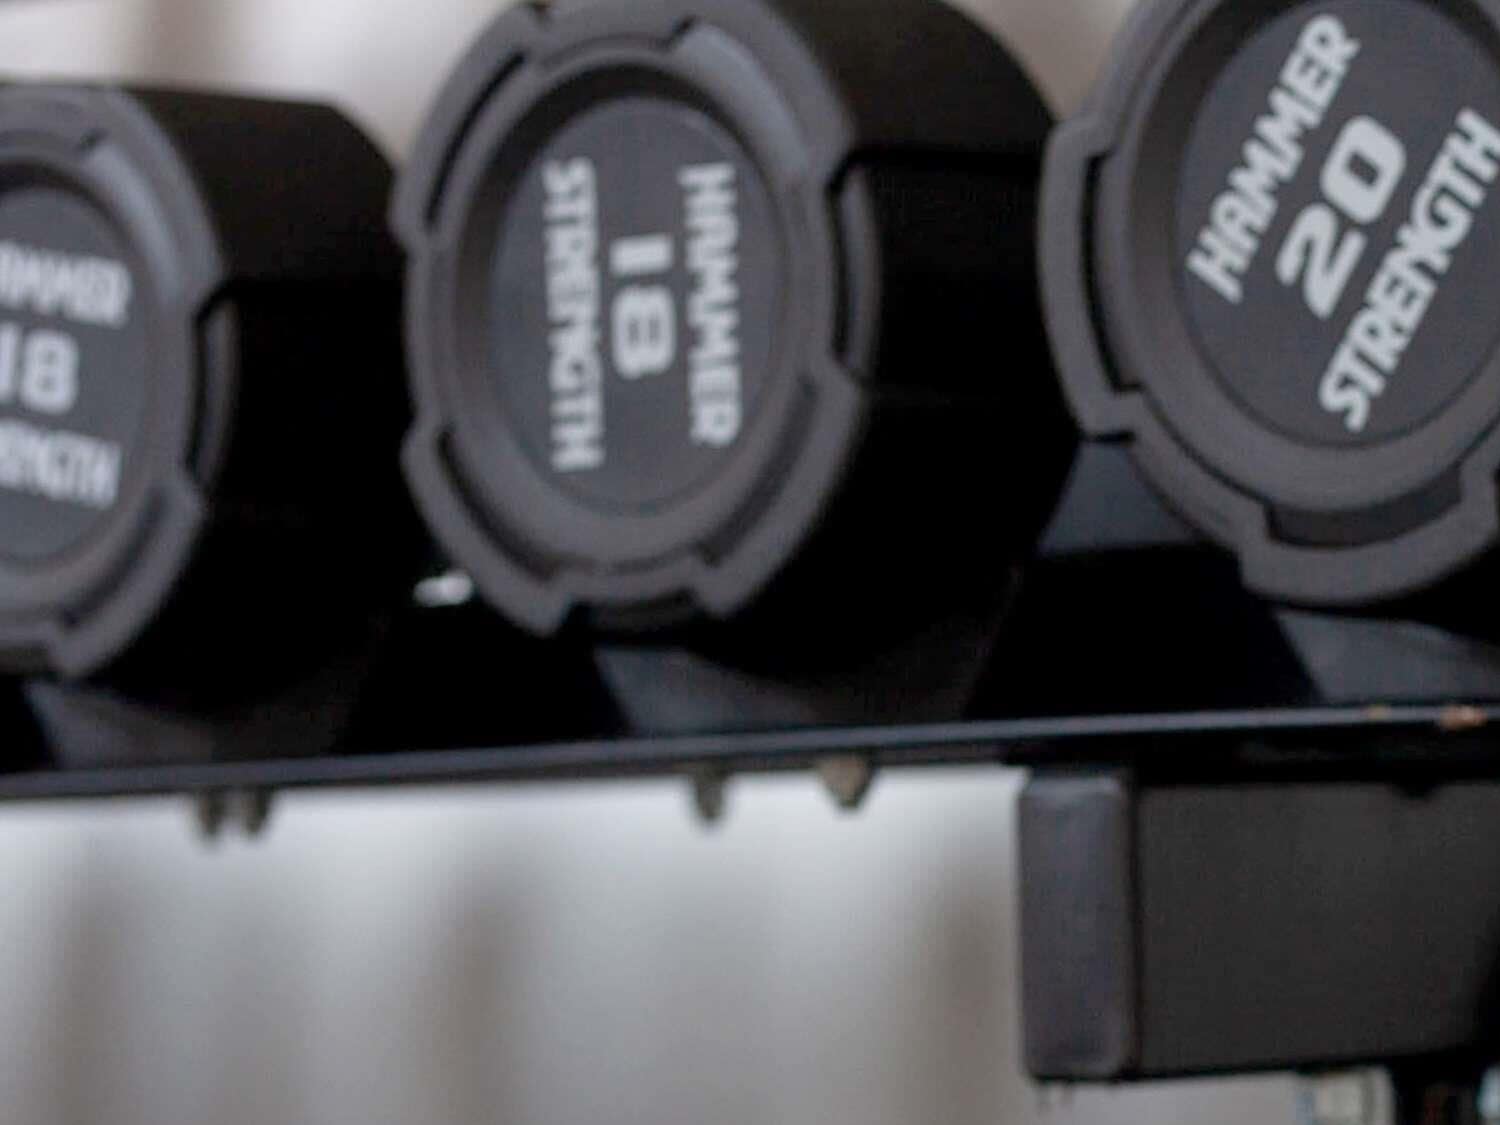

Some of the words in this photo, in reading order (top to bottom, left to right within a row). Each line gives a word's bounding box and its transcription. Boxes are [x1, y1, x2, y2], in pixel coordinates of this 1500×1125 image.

[1187, 14, 1360, 303] HAMMER
[1275, 115, 1407, 319] 20
[0, 323, 79, 413] 18
[544, 158, 603, 471] STRENGTH
[610, 235, 675, 378] 18
[679, 163, 741, 446] HAMMER
